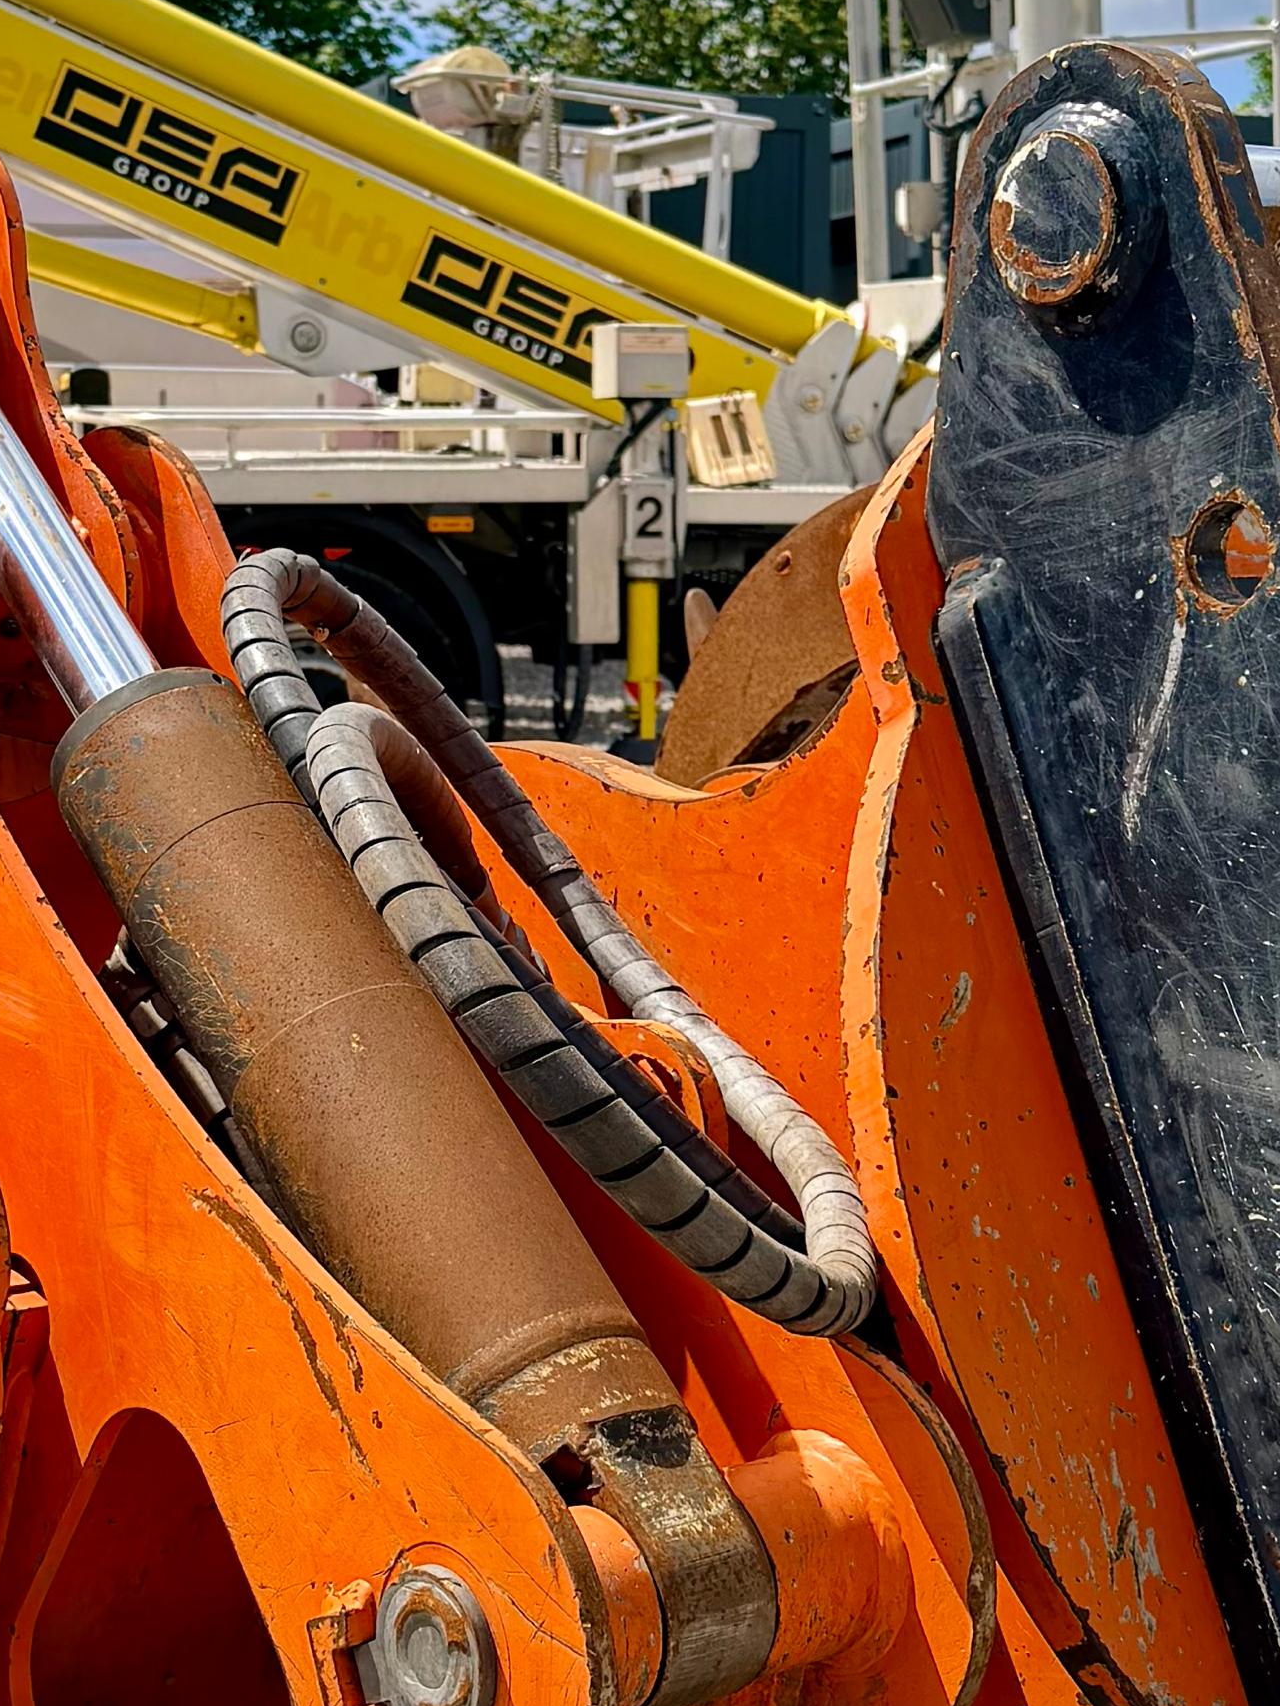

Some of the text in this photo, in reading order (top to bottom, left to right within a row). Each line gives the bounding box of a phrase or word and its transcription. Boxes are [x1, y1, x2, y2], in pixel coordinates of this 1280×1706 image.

[113, 155, 211, 209] GROUP
[472, 316, 565, 369] GROUP
[636, 495, 663, 538] 2
